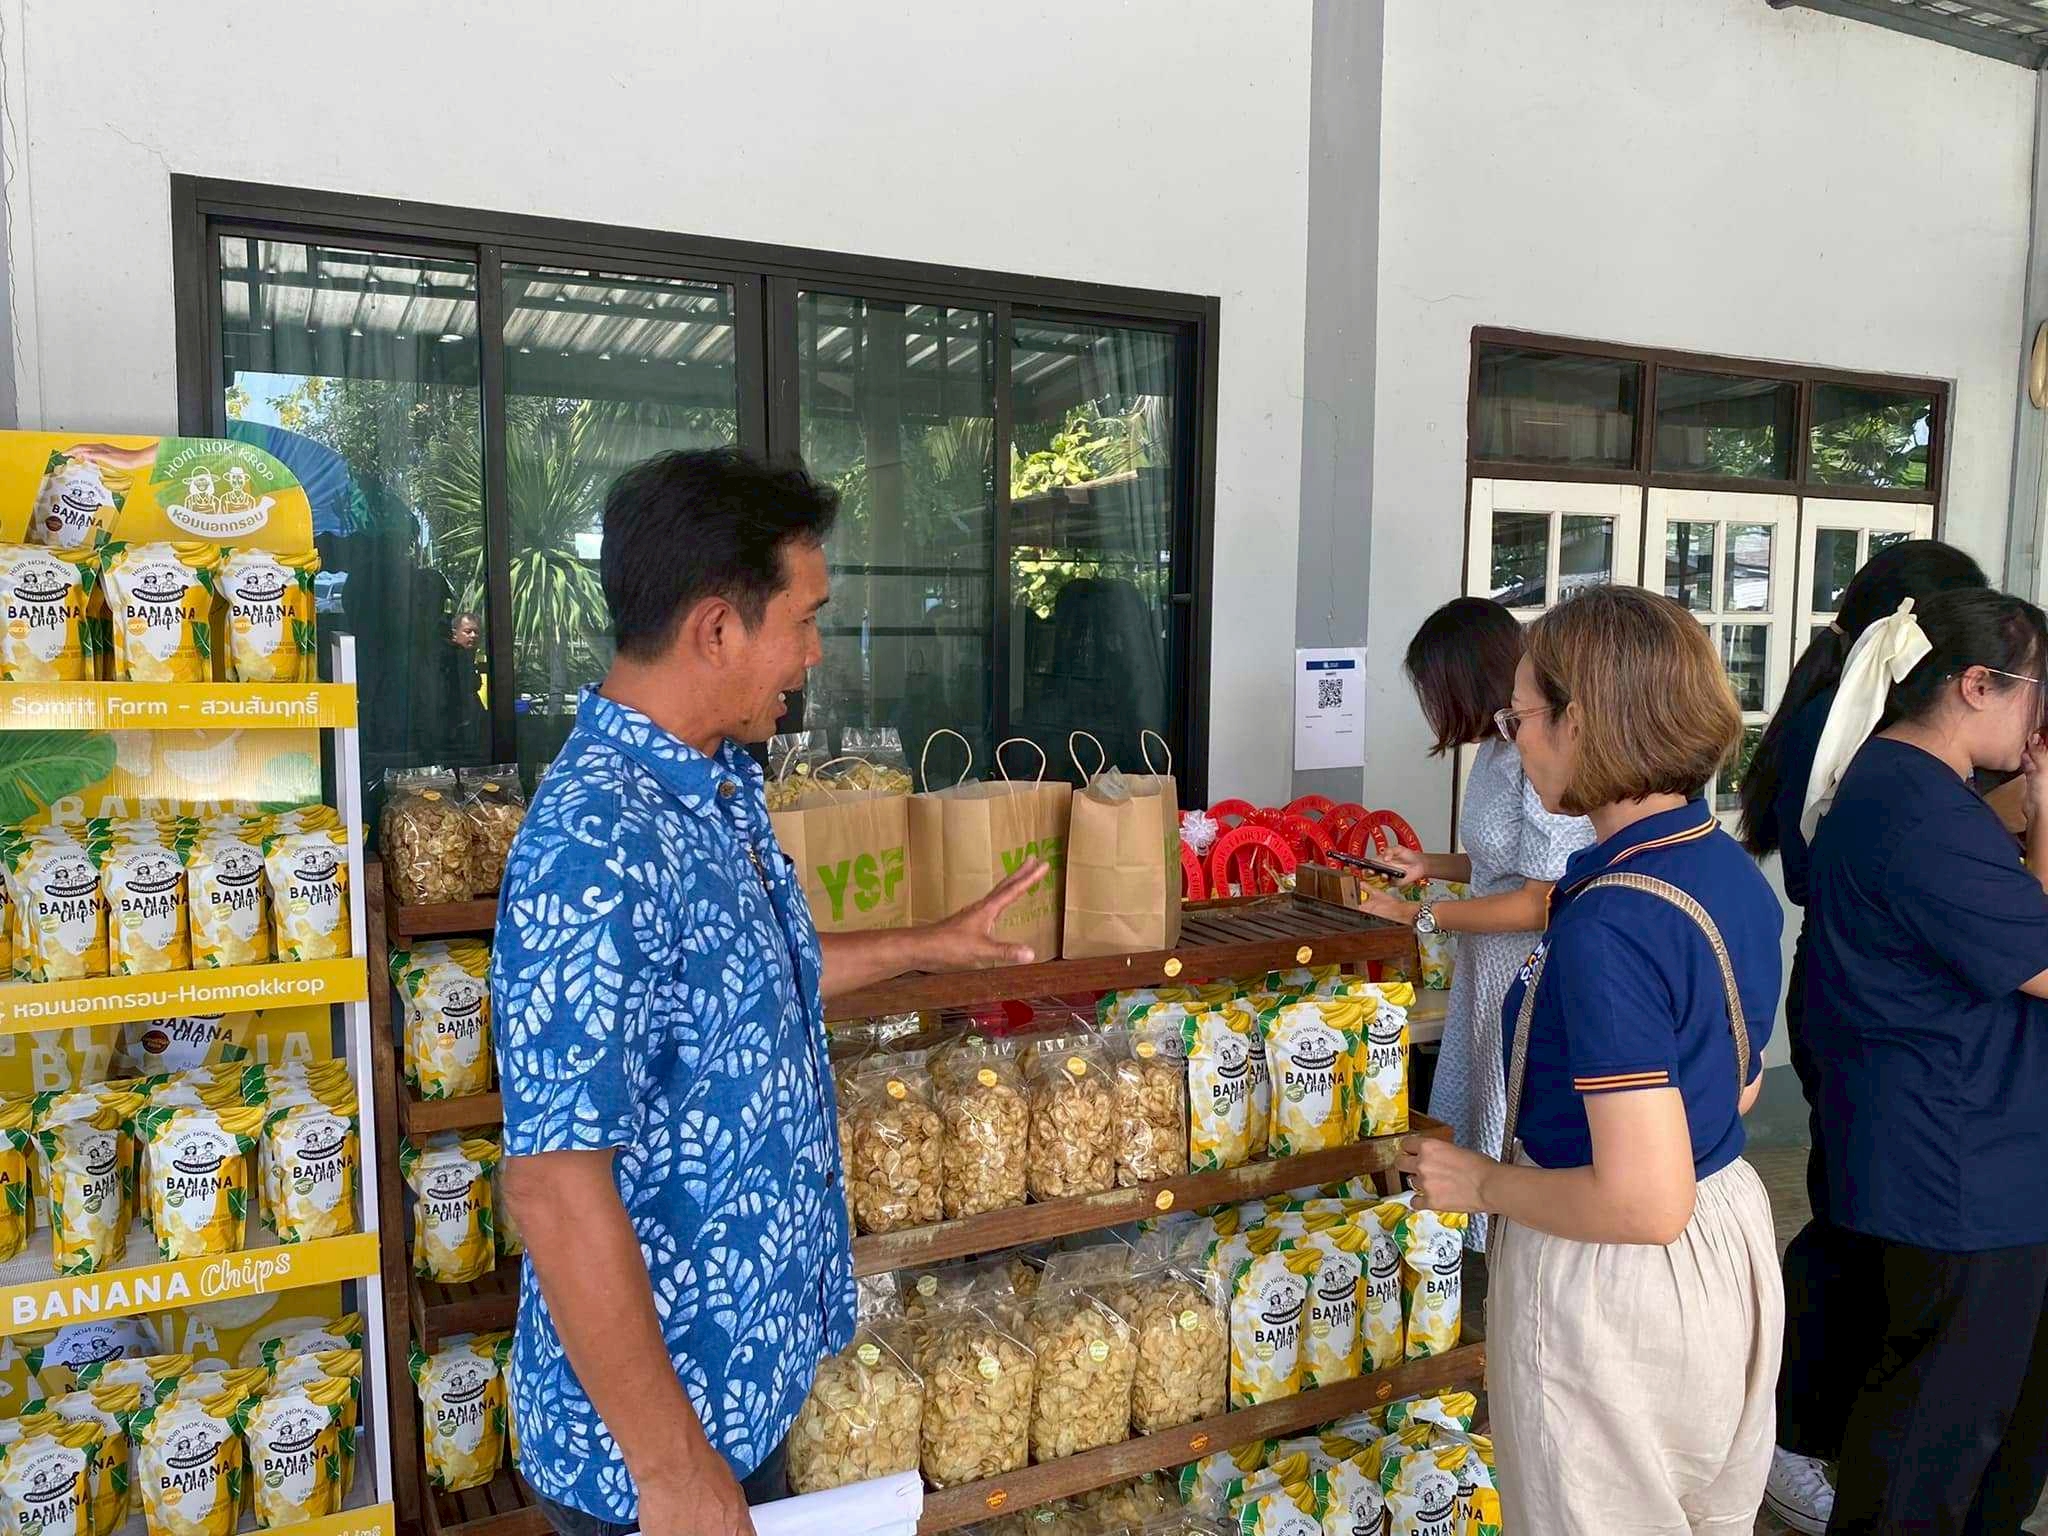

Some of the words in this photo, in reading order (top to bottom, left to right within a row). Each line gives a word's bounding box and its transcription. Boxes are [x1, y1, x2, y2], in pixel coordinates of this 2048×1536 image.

[164, 447, 197, 479] HOM
[200, 441, 235, 455] NOK
[238, 447, 274, 481] KROP
[52, 503, 103, 528] BANANA
[8, 605, 80, 619] BANANA
[127, 605, 195, 620] BANANA
[232, 605, 296, 618] BANANA
[250, 611, 282, 628] Chips
[30, 614, 64, 630] Chips
[147, 615, 180, 631] Chips
[12, 697, 96, 715] Somrit
[108, 697, 167, 715] Farm
[816, 846, 904, 922] YSF
[39, 899, 111, 915] BANANA
[121, 894, 188, 911] BANANA
[143, 903, 175, 919] Chips
[61, 907, 95, 924] Chips
[438, 1014, 488, 1034] BANANA
[172, 1026, 213, 1048] Chips
[1285, 1072, 1344, 1086] BANANA
[1303, 1080, 1333, 1096] Chips
[293, 1155, 353, 1178] BANANA
[167, 1175, 233, 1190] BANANA
[184, 1185, 216, 1201] Chips
[424, 1199, 481, 1215] BANANA
[13, 1272, 192, 1325] BANANA
[200, 1253, 290, 1296] Chips
[1255, 1322, 1302, 1343] BANAN
[437, 1398, 495, 1421] BANANA
[264, 1445, 329, 1471] BANANA
[161, 1460, 230, 1489] BANANA
[19, 1495, 90, 1523] BANANA
